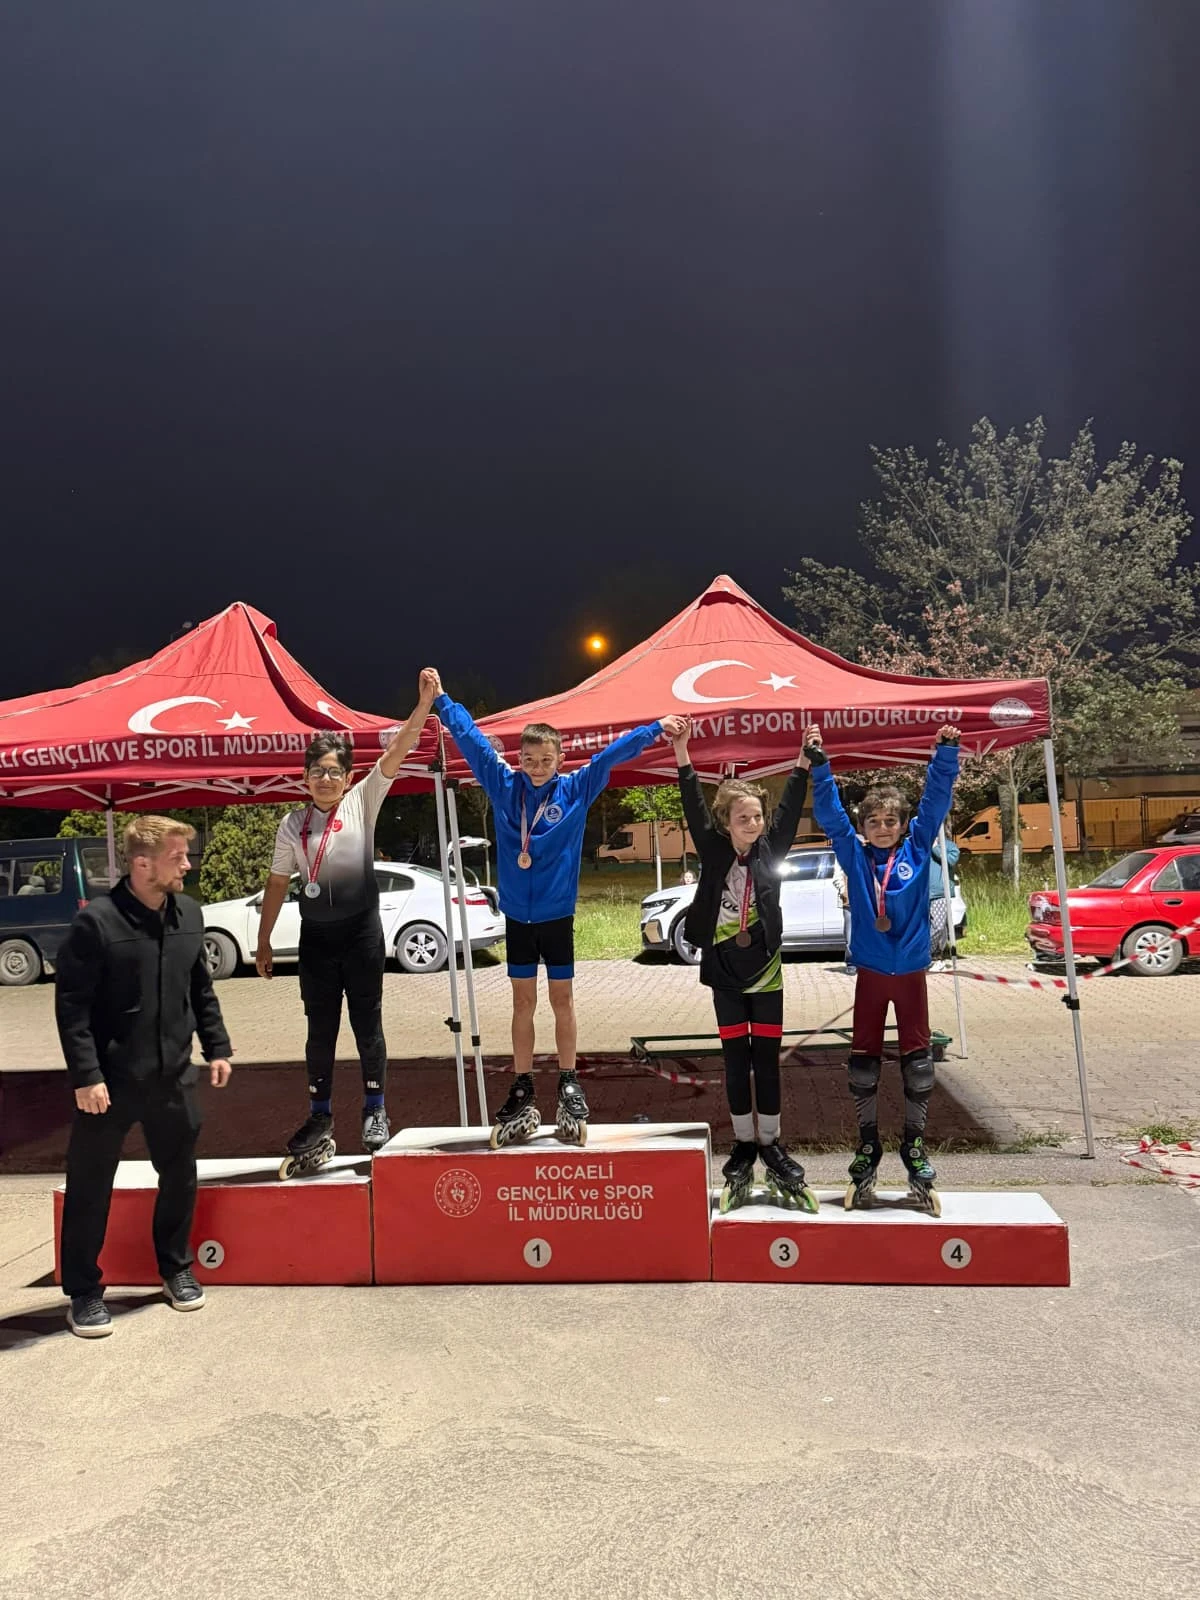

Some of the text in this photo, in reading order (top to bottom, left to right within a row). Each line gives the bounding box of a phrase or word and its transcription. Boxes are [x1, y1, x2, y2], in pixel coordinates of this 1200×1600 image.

[710, 715, 736, 737] VE
[740, 710, 795, 735] SPOR
[21, 739, 111, 769] GENÇLİK
[112, 739, 139, 761] VE
[143, 736, 195, 760] SPOR
[200, 732, 219, 758] İL
[535, 1161, 614, 1180] KOCAELİ
[497, 1182, 654, 1205] GENÇLİK ve SPOR
[508, 1202, 643, 1221] İL MÜDÜRLÜĞÜ
[206, 1246, 216, 1263] 2
[532, 1244, 542, 1262] 1
[778, 1244, 790, 1261] 3
[950, 1245, 963, 1262] 4
